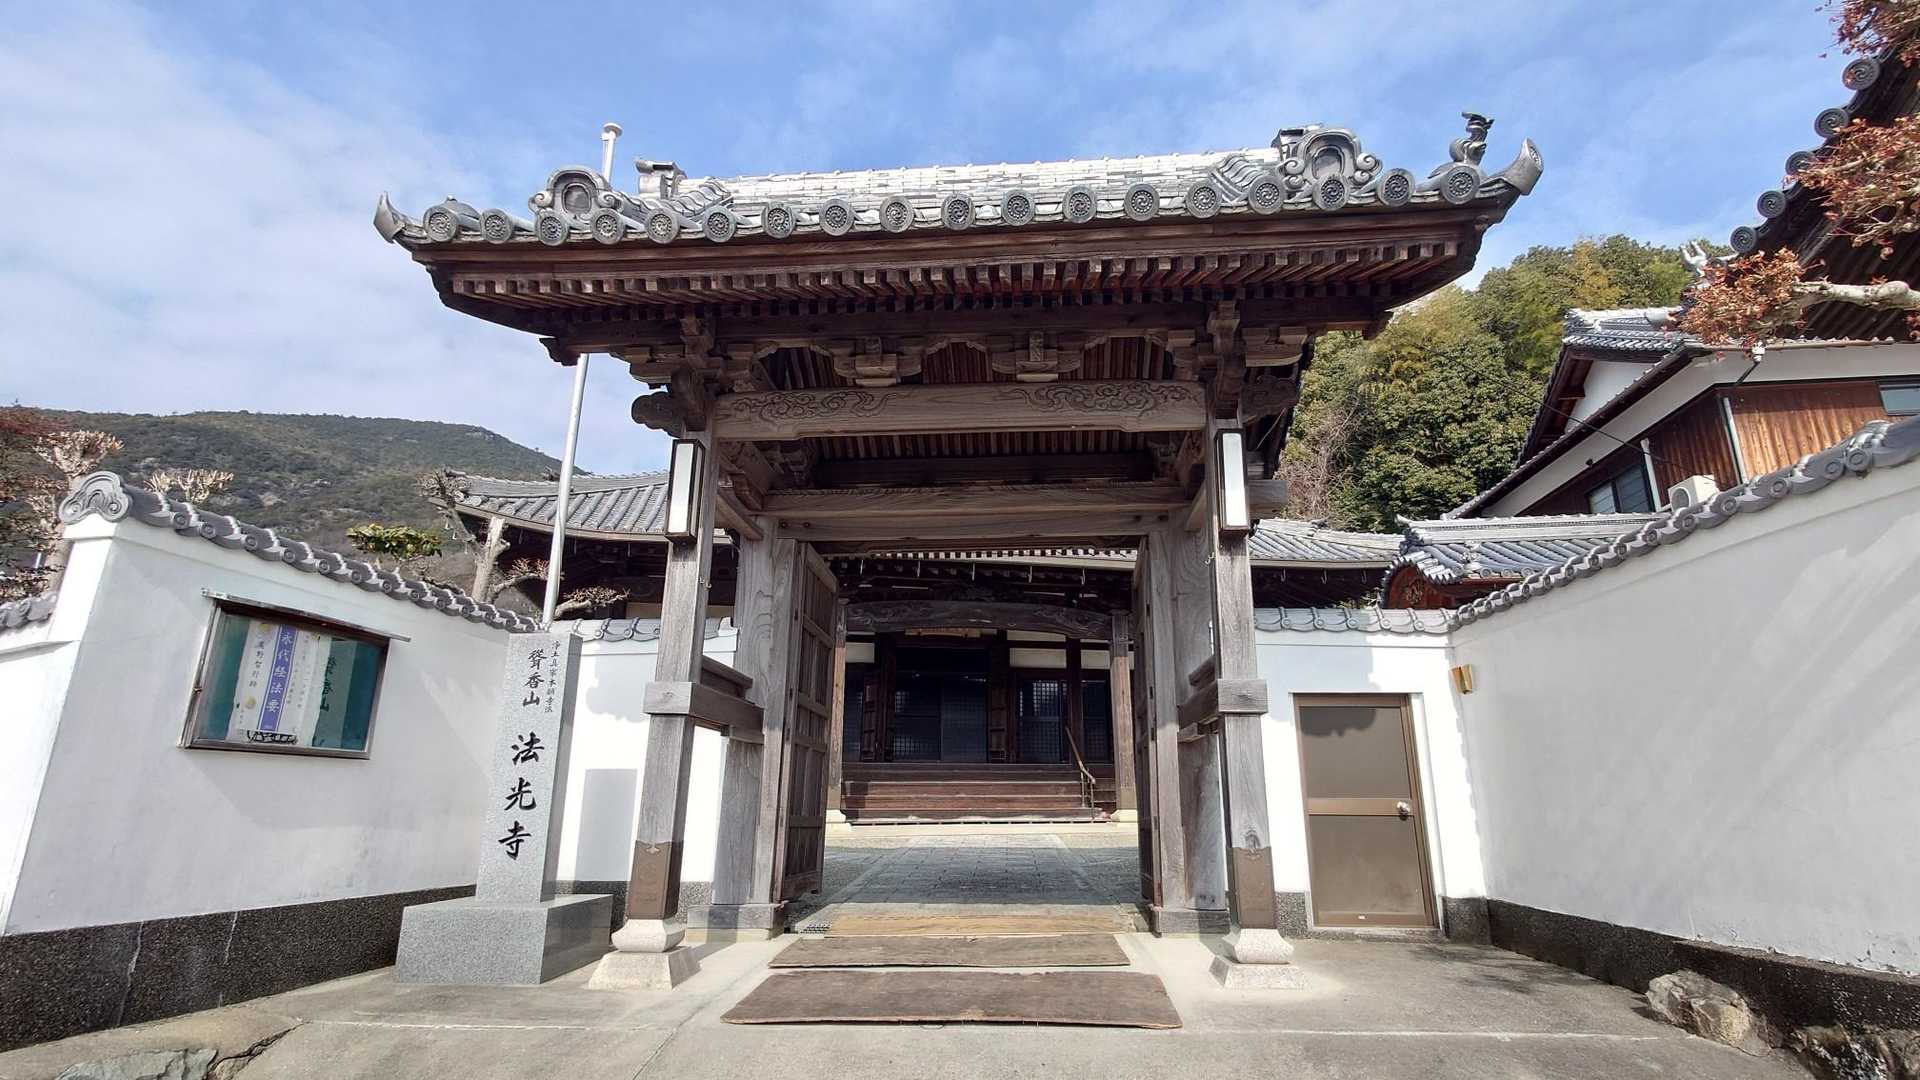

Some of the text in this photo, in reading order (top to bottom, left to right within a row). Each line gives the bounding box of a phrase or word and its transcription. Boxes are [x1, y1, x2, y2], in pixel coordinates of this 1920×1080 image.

[266, 632, 294, 713] 永代経法要
[498, 731, 545, 861] 法光寺
